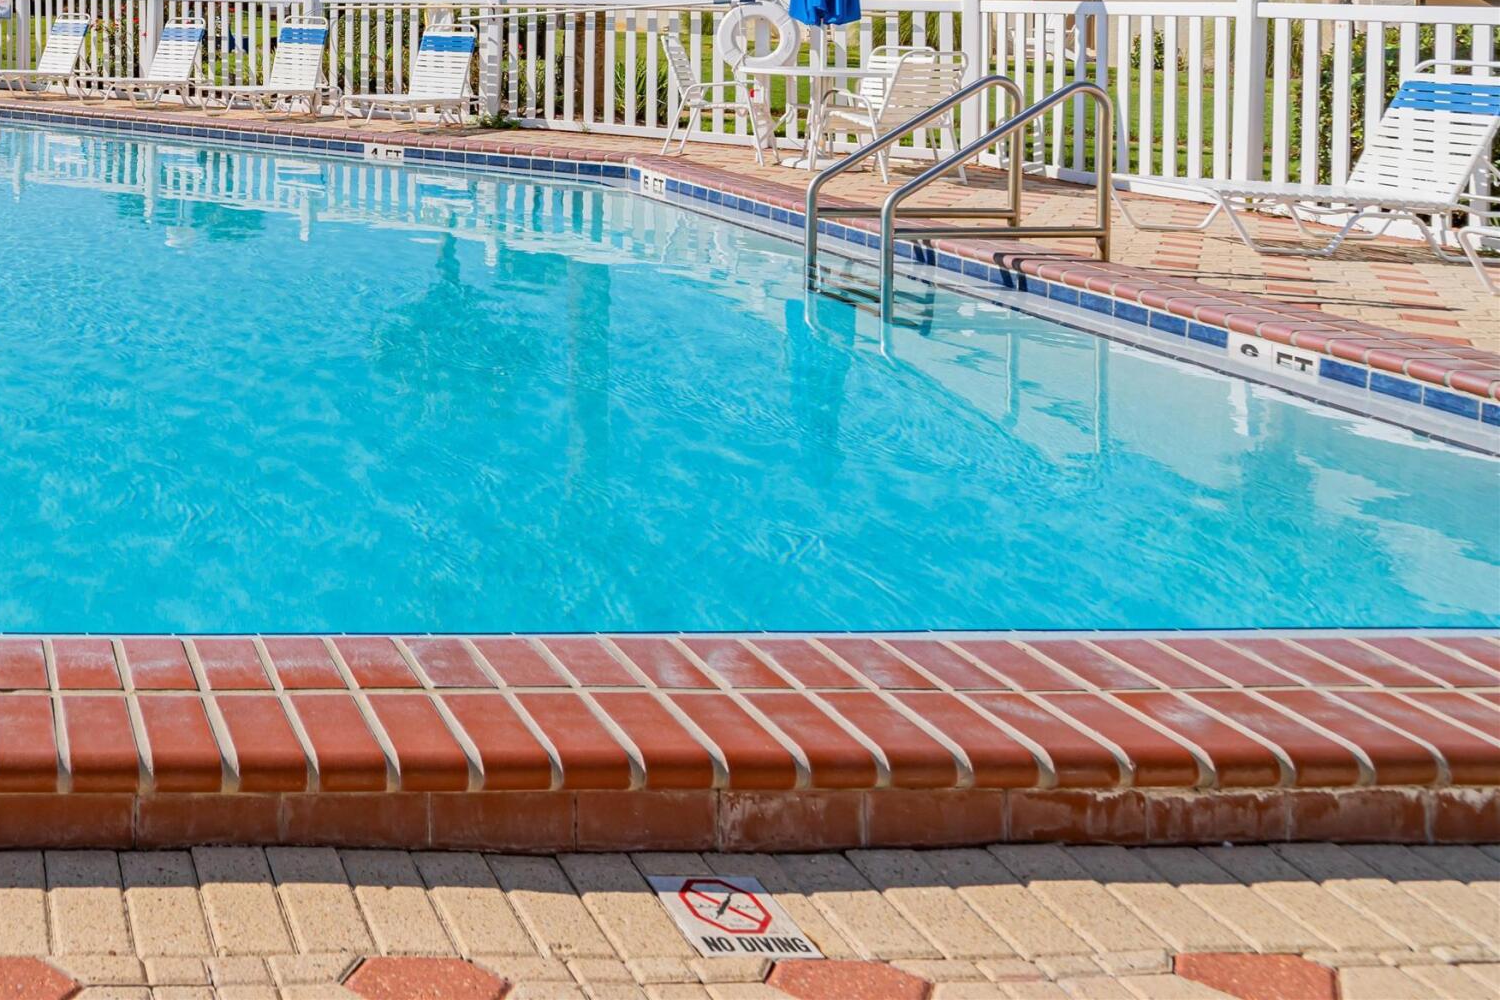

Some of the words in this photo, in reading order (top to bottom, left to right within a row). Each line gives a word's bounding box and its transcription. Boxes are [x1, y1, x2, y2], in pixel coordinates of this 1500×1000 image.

[1276, 351, 1313, 373] FT
[701, 936, 735, 952] NO
[736, 936, 812, 952] DIVING
